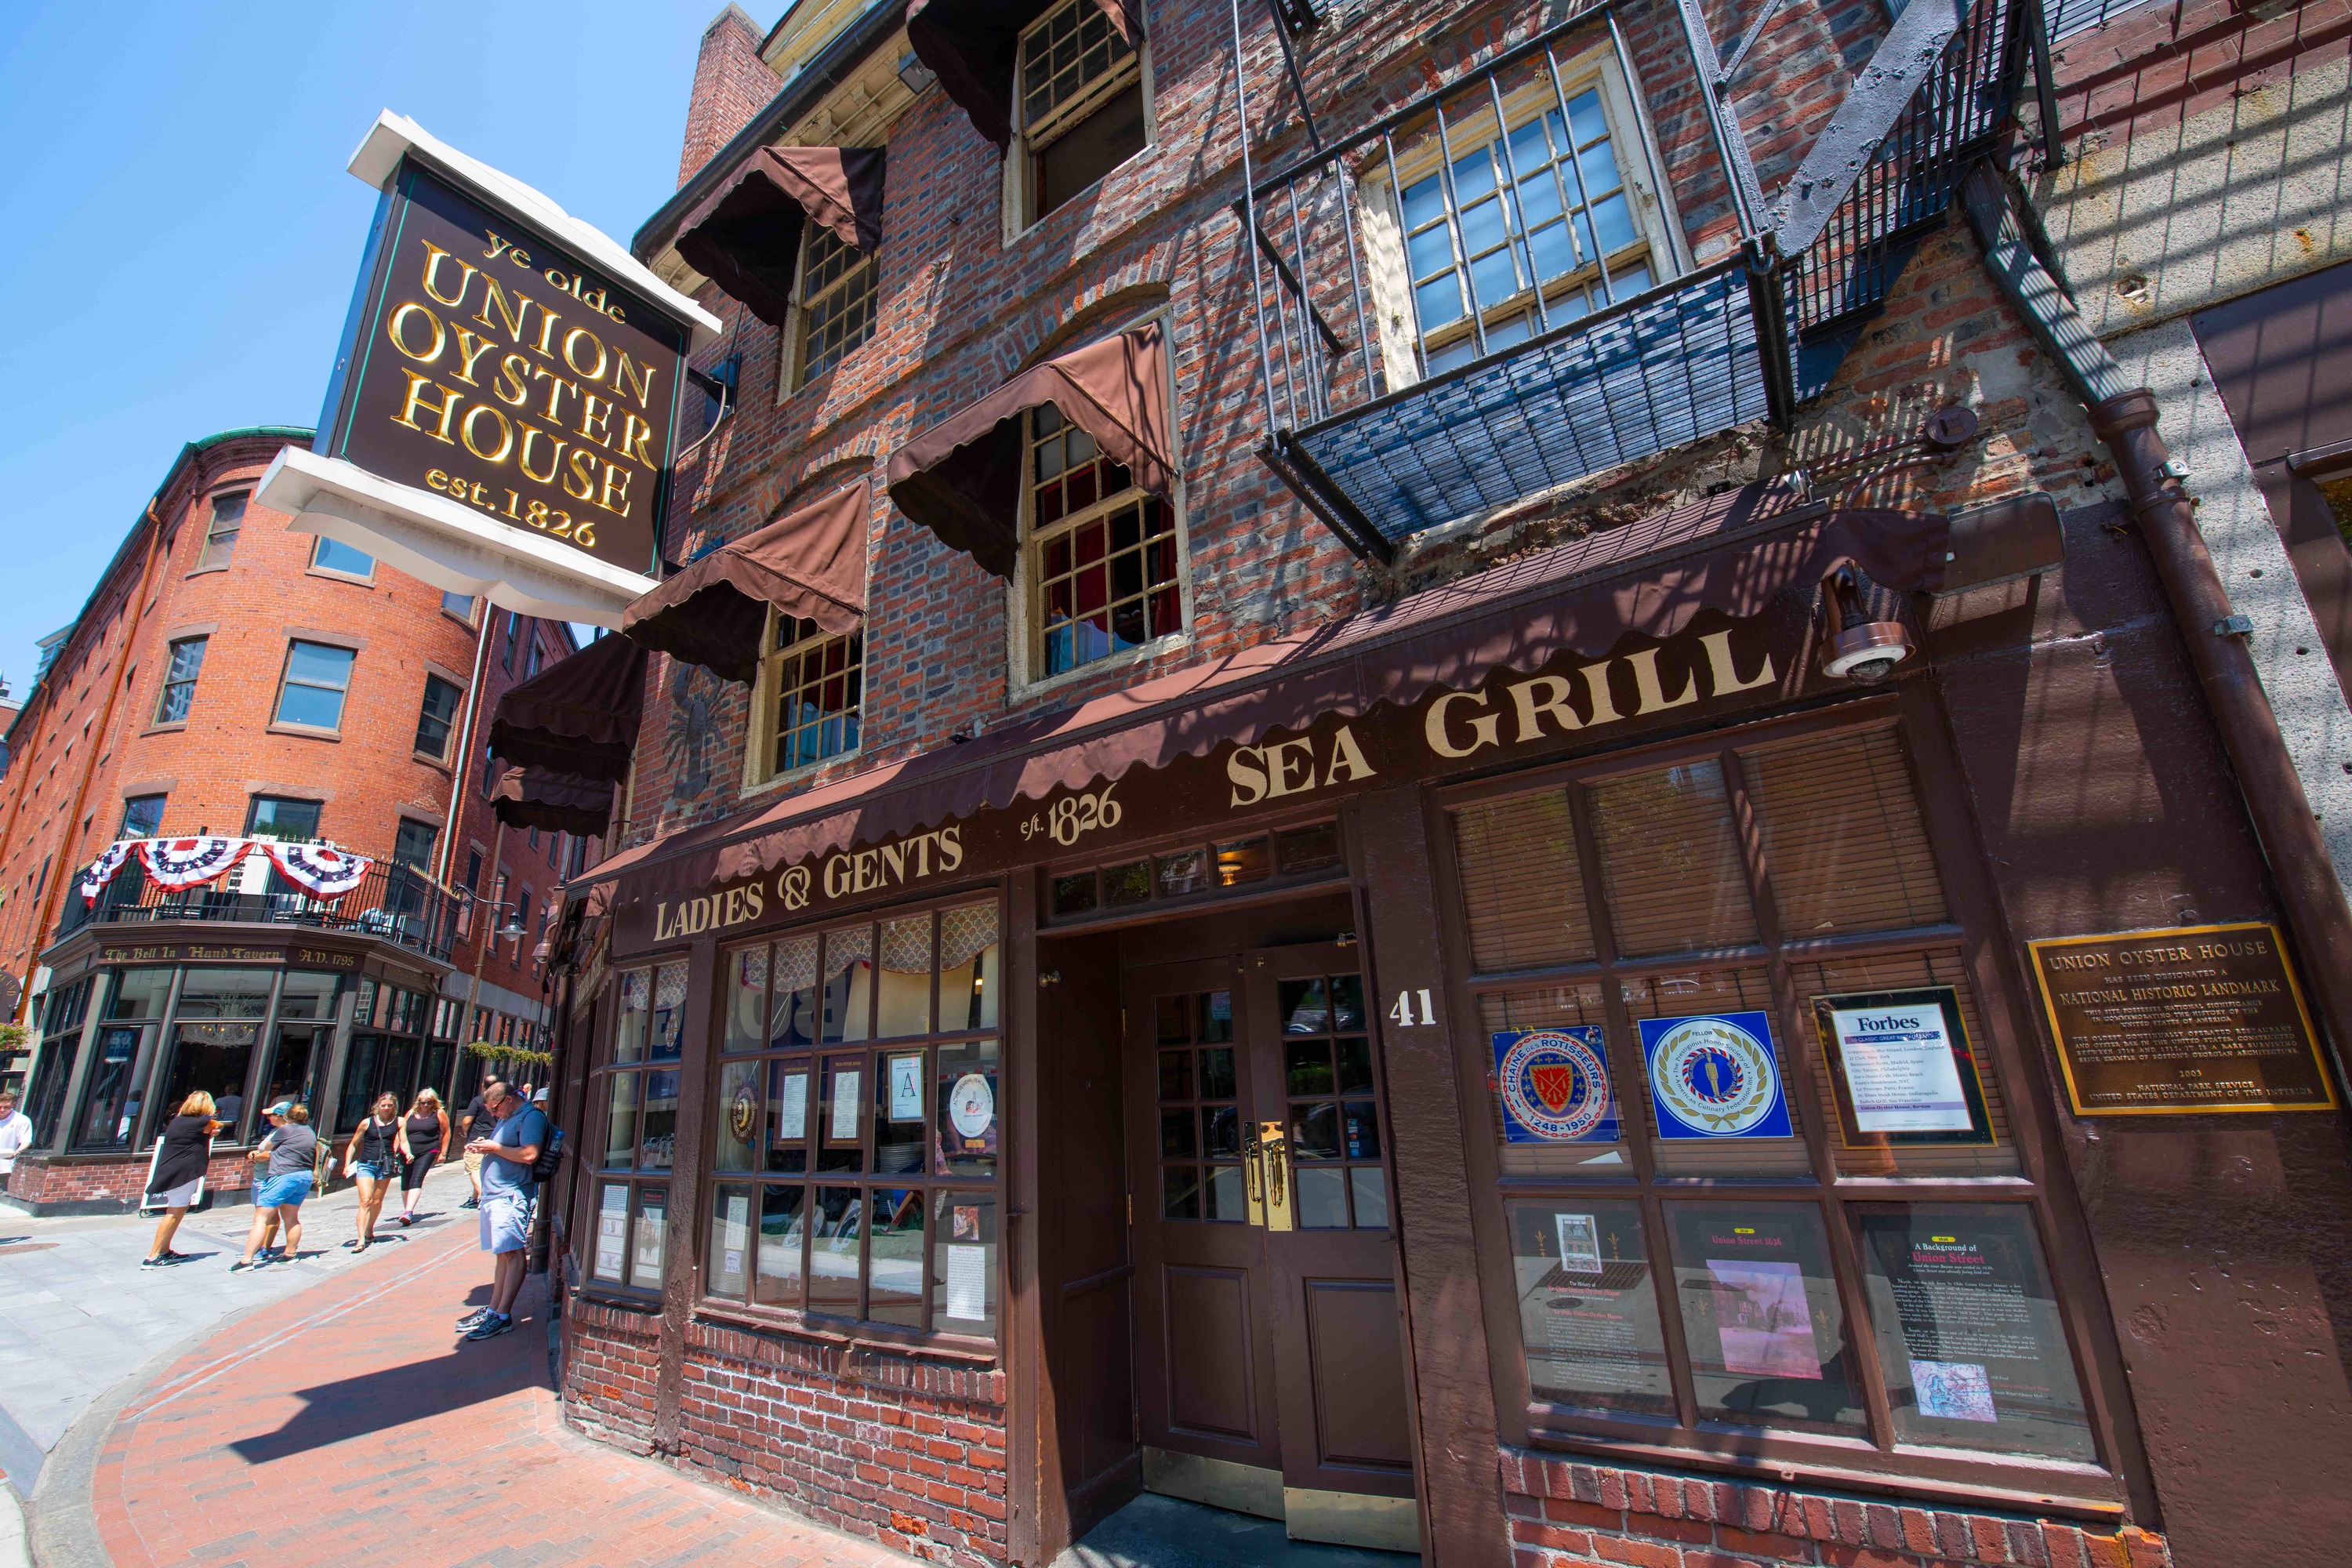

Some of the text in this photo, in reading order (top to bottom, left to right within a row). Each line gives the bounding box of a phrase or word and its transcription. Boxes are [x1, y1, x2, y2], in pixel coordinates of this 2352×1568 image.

[484, 229, 626, 324] ye olde
[422, 239, 656, 408] UNION
[387, 301, 657, 471] OYSTER
[390, 367, 631, 517] HOUSE
[1229, 628, 1777, 810] SEA GRILL
[1048, 782, 1123, 846] 1826
[654, 823, 964, 942] LADIES & GENTS
[105, 946, 281, 961] The Bell In Hand Tavern
[332, 954, 354, 967] 1795
[2049, 942, 2267, 970] UNION OYSTER HOUSE
[2154, 970, 2216, 980] DESIGNATED
[2060, 980, 2281, 1005] NATIONAL HISTORIC LANDMARK
[2207, 1000, 2263, 1009] SIGNIFICANCE
[1388, 988, 1437, 1027] 41
[2103, 1012, 2171, 1022] COMMEMORATING
[1857, 1015, 1920, 1032] Forbes
[2125, 1031, 2183, 1040] CONTINUALLY
[2235, 1025, 2292, 1034] RESTAURANT
[1675, 1040, 1702, 1062] Prestigious
[1725, 1043, 1746, 1064] Society
[2248, 1040, 2297, 1049] SURVIVING
[1508, 1039, 1601, 1093] CHAINE DES ROTISSEURS
[901, 1073, 916, 1097] A
[953, 1078, 972, 1106] ACHIEVEMENT
[1675, 1079, 1697, 1105] American
[1697, 1102, 1725, 1113] Culinary
[2162, 1090, 2223, 1098] DEPARTMENT
[2266, 1087, 2314, 1096] INTERIOR
[1711, 1235, 1782, 1247] Union Street 1636
[1922, 1243, 1967, 1252] Background
[1911, 1251, 1986, 1264] Union Street
